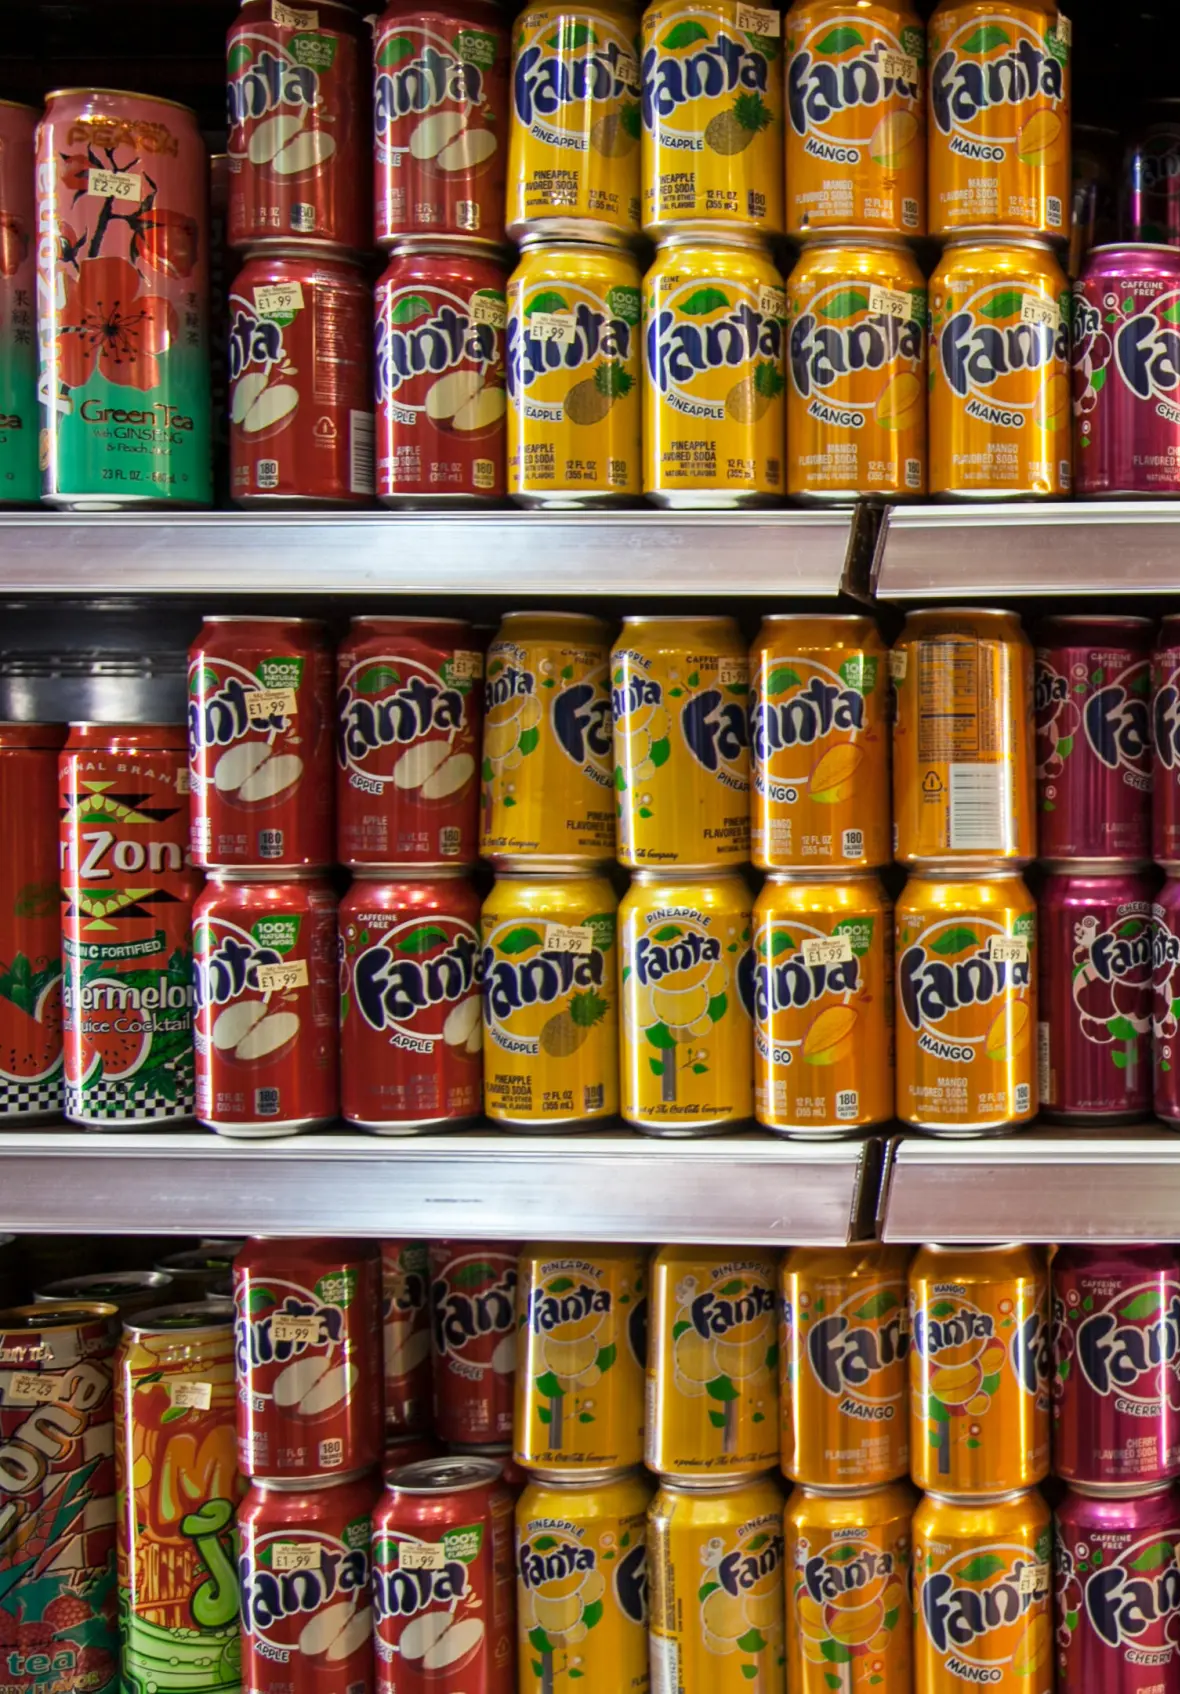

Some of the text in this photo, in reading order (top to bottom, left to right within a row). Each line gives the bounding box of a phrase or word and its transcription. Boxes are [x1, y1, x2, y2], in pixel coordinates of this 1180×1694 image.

[642, 33, 768, 131] Fanta
[929, 37, 1063, 136] Fanta
[531, 125, 589, 151] PINEAPPLE
[949, 136, 1006, 162] MANGO
[804, 137, 861, 164] MANGO
[1120, 281, 1164, 290] CAFFEINE
[1133, 288, 1155, 297] FREE
[645, 302, 781, 397] Fanta
[790, 311, 924, 399] Fanta
[80, 399, 194, 431] Green Tea
[665, 391, 725, 421] PINEAPPLE
[807, 400, 865, 428] MANGO
[964, 399, 1026, 428] MANGO
[260, 463, 276, 475] 180
[261, 663, 299, 675] 100%
[337, 676, 466, 770] Fanta
[117, 764, 179, 786] BRAN
[348, 773, 384, 794] APPLE
[846, 832, 862, 844] 180
[257, 922, 296, 933] 100%
[357, 913, 397, 922] CAFFEINE
[368, 921, 389, 929] FREE
[645, 907, 711, 926] PINEAPPLE
[260, 932, 295, 940] NATURAL
[88, 944, 99, 955] C
[101, 940, 161, 958] FORTIFIED
[636, 931, 721, 986] Fanta
[80, 1016, 110, 1032] uice
[113, 1012, 190, 1033] Cocktail
[490, 1028, 539, 1054] PINEAPPLE
[918, 1034, 975, 1063] MANGO
[839, 1092, 857, 1105] 180
[540, 1261, 605, 1280] PINEAPPLE
[532, 1286, 612, 1333] Fanta
[691, 1285, 776, 1339] Fanta
[915, 1309, 993, 1356] Fanta
[839, 1398, 895, 1419] MANGO
[1115, 1398, 1164, 1417] CHERRY
[444, 1532, 479, 1546] 100%
[527, 1519, 585, 1538] PINEAPPLE
[832, 1528, 868, 1539] MANGO
[1090, 1533, 1132, 1543] CAFFEINE
[1102, 1541, 1123, 1550] FREE
[521, 1543, 596, 1590] Fanta
[805, 1550, 893, 1603] Fanta
[7, 1648, 77, 1677] tea
[255, 1641, 290, 1664] APPLE
[1125, 1648, 1172, 1665] CHERRY
[944, 1657, 1002, 1683] MANGO
